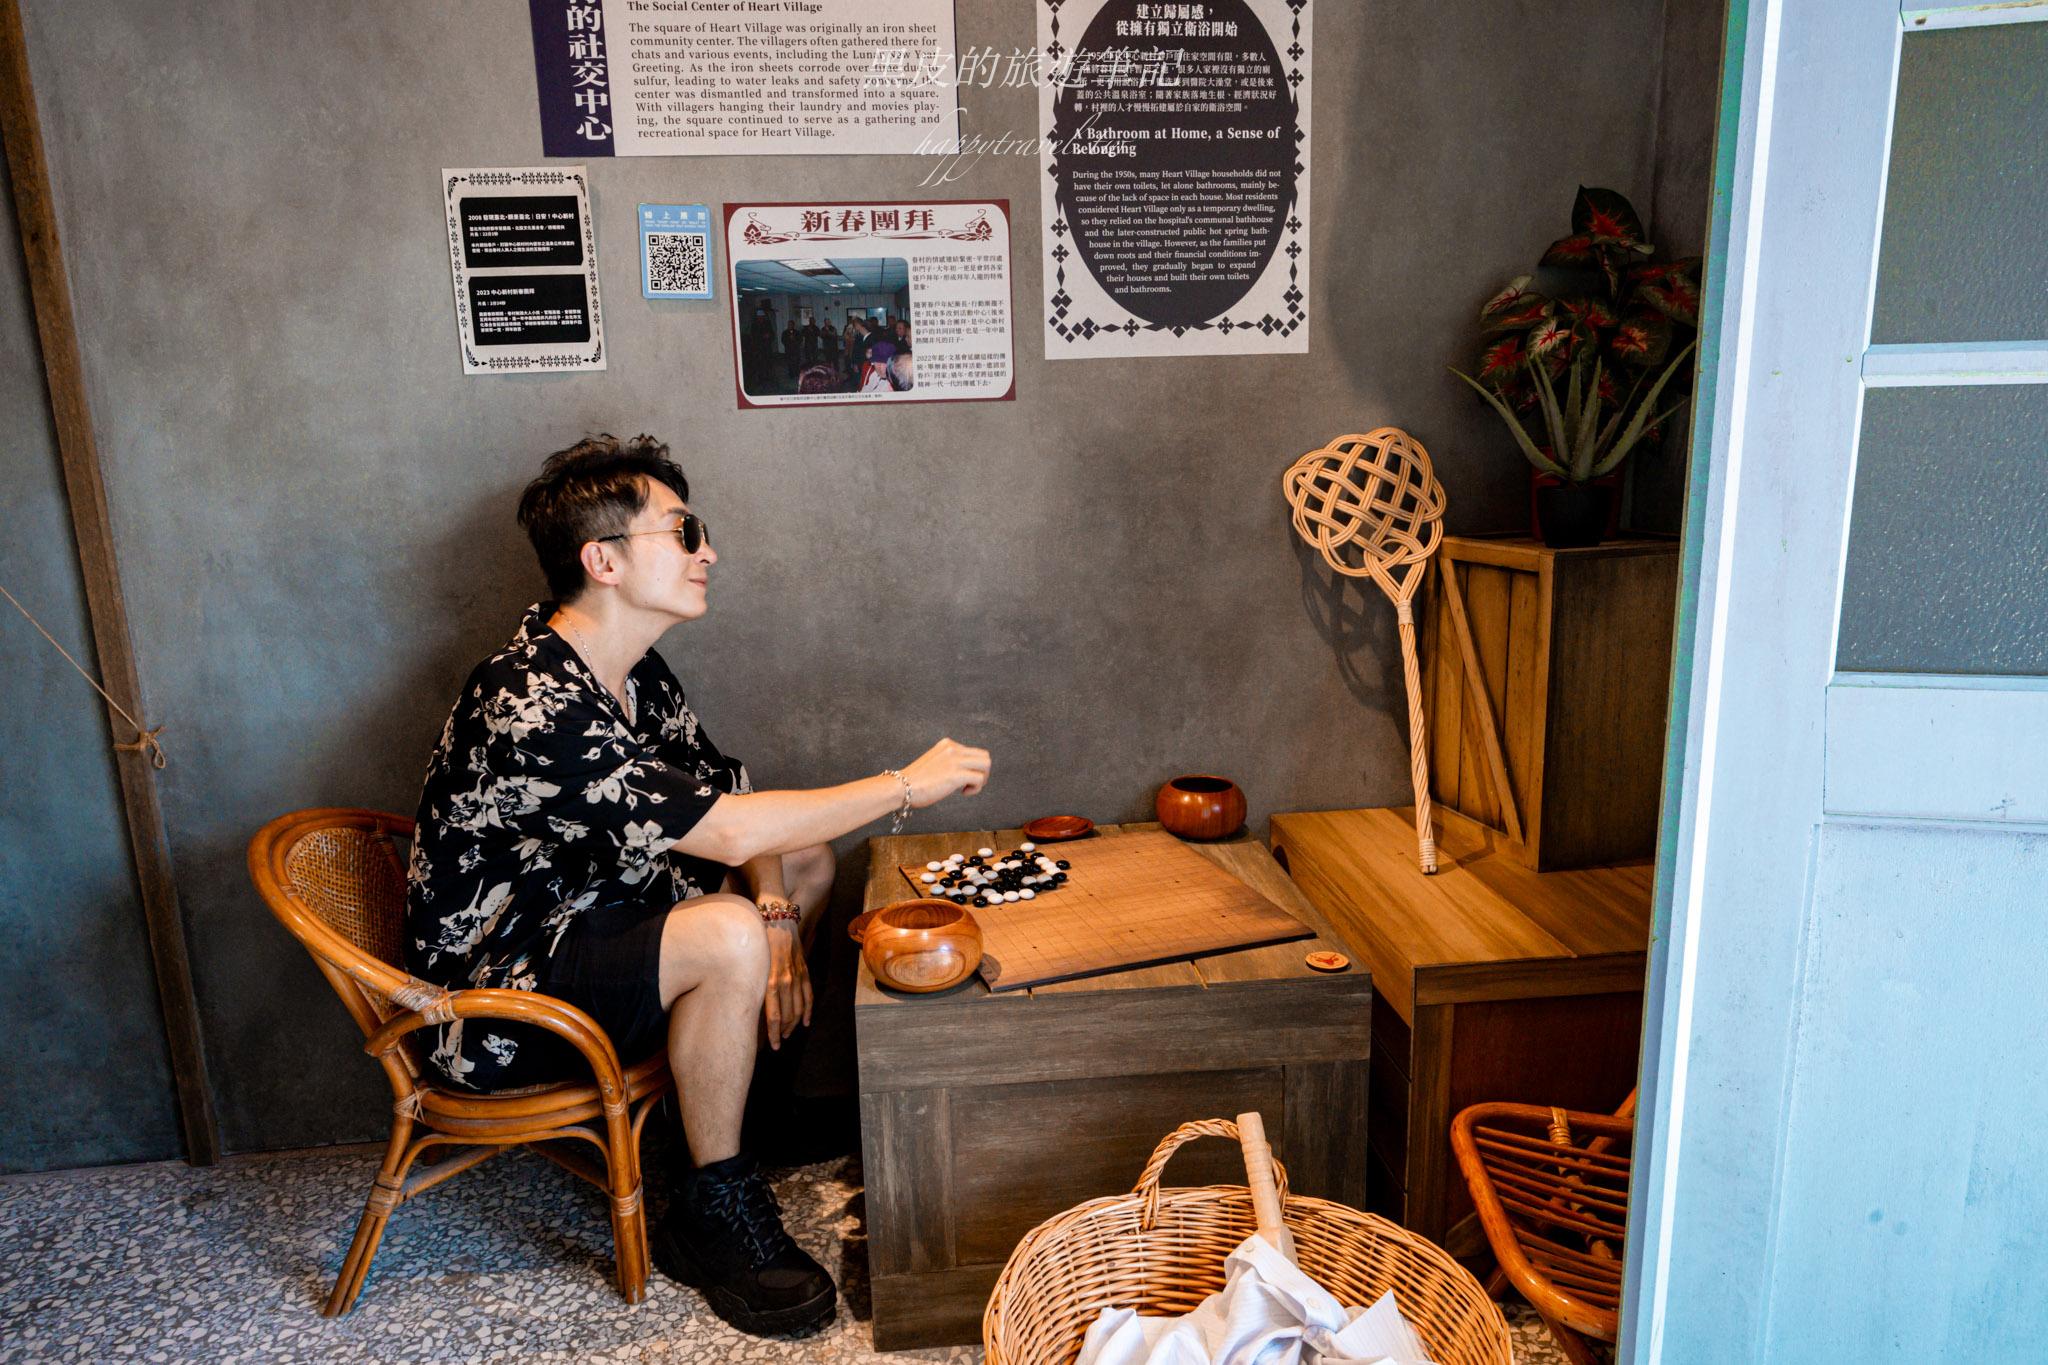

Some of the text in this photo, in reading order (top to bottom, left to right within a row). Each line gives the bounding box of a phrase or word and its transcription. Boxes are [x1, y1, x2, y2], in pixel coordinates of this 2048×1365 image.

[626, 0, 823, 14] The Social Center of Heart Village
[628, 21, 650, 32] The
[653, 24, 691, 35] square
[694, 22, 706, 32] of
[709, 22, 740, 32] Heart
[744, 22, 782, 34] Village
[809, 22, 862, 35] originally
[882, 22, 905, 33] iron
[908, 22, 936, 32] sheet
[1116, 20, 1238, 37] 從擁有獨立衛浴開始
[629, 35, 936, 48] community center. The villagers often gathered there for
[630, 48, 661, 59] chats
[664, 48, 685, 59] and
[688, 48, 730, 59] various
[733, 49, 772, 60] events,
[775, 48, 828, 61] including
[831, 49, 848, 59] the
[566, 0, 612, 140] 的社交中心
[632, 62, 684, 74] Greeting.
[689, 63, 703, 72] As
[707, 62, 726, 72] the
[730, 62, 754, 72] iron
[758, 61, 793, 72] sheets
[798, 62, 840, 72] corrode
[633, 75, 860, 87] sulfur, leading to water leaks and safety
[634, 90, 670, 98] center
[700, 88, 762, 98] dismantled
[766, 88, 787, 98] and
[791, 88, 858, 98] transformed
[863, 88, 885, 98] into
[900, 90, 939, 100] square.
[635, 100, 939, 113] With villagers hanging their laundry and movies play-
[636, 115, 658, 127] ing,
[663, 114, 681, 124] the
[686, 116, 723, 127] square
[727, 114, 783, 124] continued
[788, 115, 799, 123] to
[864, 113, 916, 126] gathering
[920, 113, 940, 123] and
[638, 126, 835, 139] recreational space for Heart Village.
[1073, 125, 1281, 141] A Bathroom at Home, a Sense of
[1072, 142, 1136, 158] Belonging
[1072, 170, 1099, 180] During
[1100, 170, 1113, 178] the
[1115, 170, 1137, 179] 1950s,
[1139, 171, 1160, 179] many
[1184, 169, 1210, 179] Village
[1211, 168, 1253, 177] households
[1254, 168, 1267, 177] did
[1073, 182, 1091, 190] have
[1093, 181, 1112, 190] their
[1132, 181, 1158, 190] toilets,
[1160, 181, 1171, 189] let
[1172, 181, 1194, 189] alone
[1195, 180, 1238, 190] bathrooms,
[1240, 180, 1265, 190] mainly
[1268, 180, 1279, 188] be-
[800, 208, 936, 233] 新春團拜
[1084, 226, 1270, 237] and the later-constructed public hot spring bath-
[1093, 251, 1114, 259] down
[1137, 250, 1152, 258] and
[1153, 250, 1172, 258] their
[1174, 249, 1206, 258] financial
[1208, 249, 1247, 257] conditions
[1099, 262, 1128, 272] proved,
[1131, 262, 1148, 272] they
[1152, 261, 1187, 271] gradually
[1191, 261, 1213, 270] began
[1229, 260, 1256, 270] expand
[1106, 274, 1124, 282] their
[1126, 273, 1152, 281] houses
[1153, 273, 1168, 281] and
[1170, 272, 1187, 281] built
[1189, 272, 1207, 280] their
[1114, 284, 1172, 293] and bathrooms.
